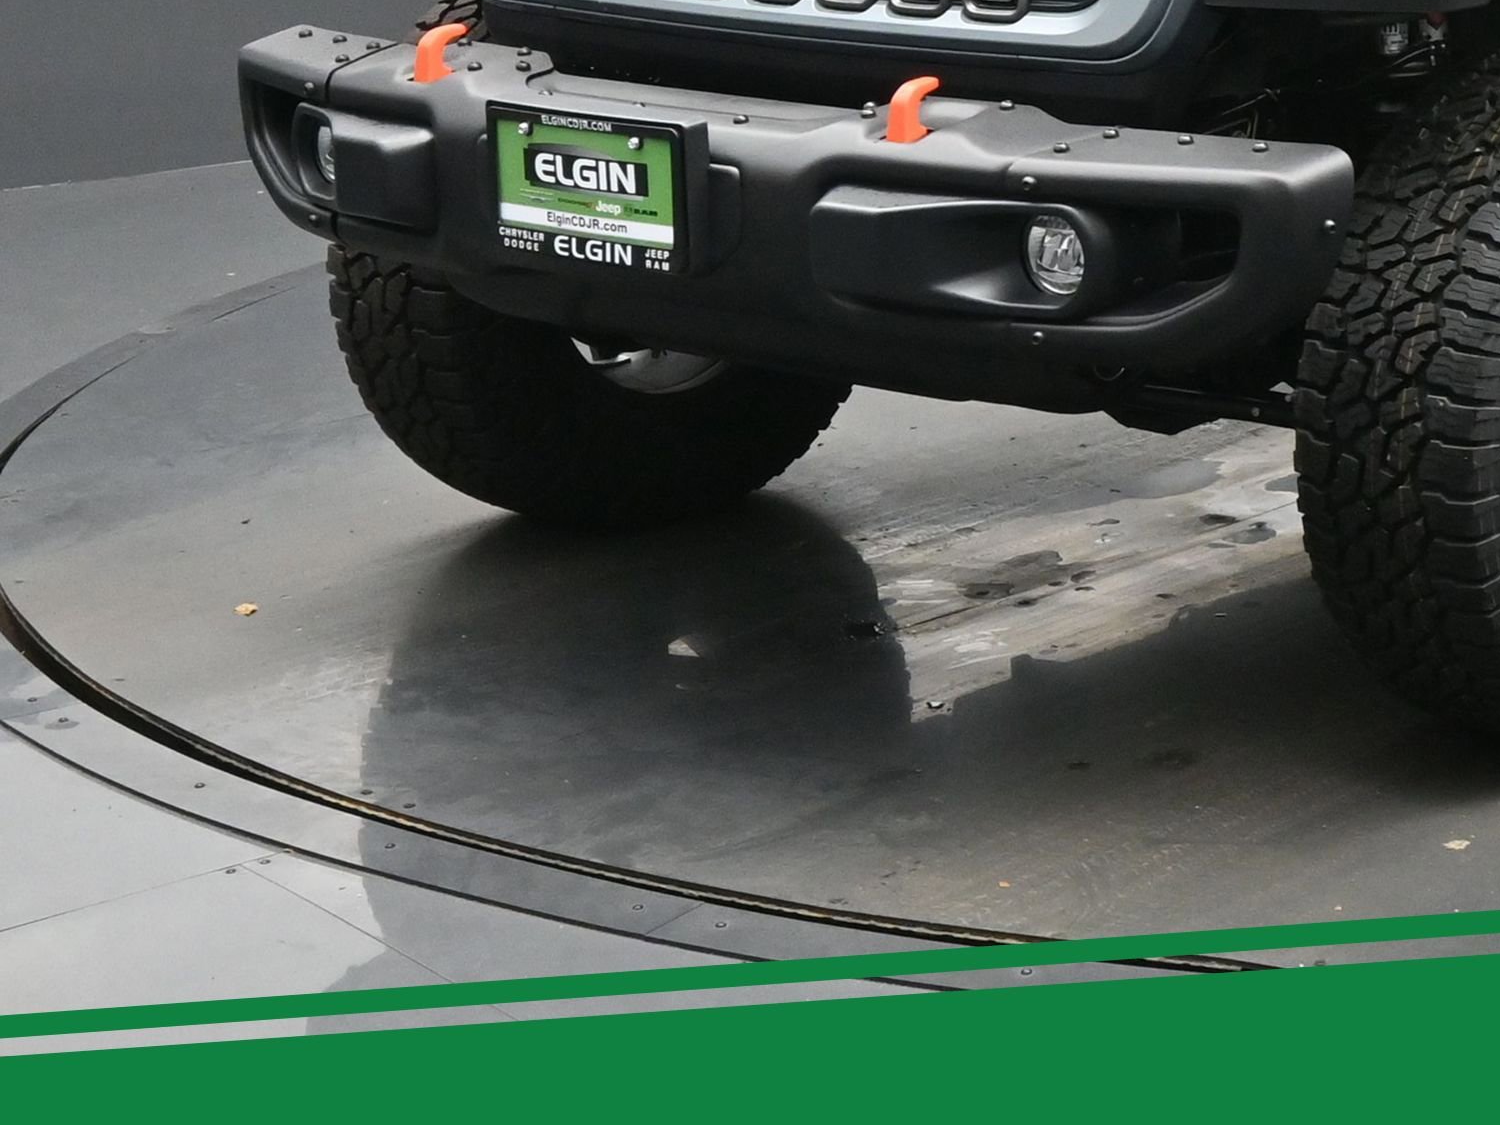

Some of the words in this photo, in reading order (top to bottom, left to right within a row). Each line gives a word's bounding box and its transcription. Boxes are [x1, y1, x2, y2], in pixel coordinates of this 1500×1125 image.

[534, 152, 637, 194] ELGIN
[595, 200, 622, 216] Jeep
[547, 211, 628, 234] ElginCDJR.com
[498, 226, 545, 242] CHRYSLER
[503, 237, 540, 252] DODGE
[553, 235, 633, 266] ELGIN
[644, 249, 671, 260] JEEP
[644, 259, 671, 272] RAM
